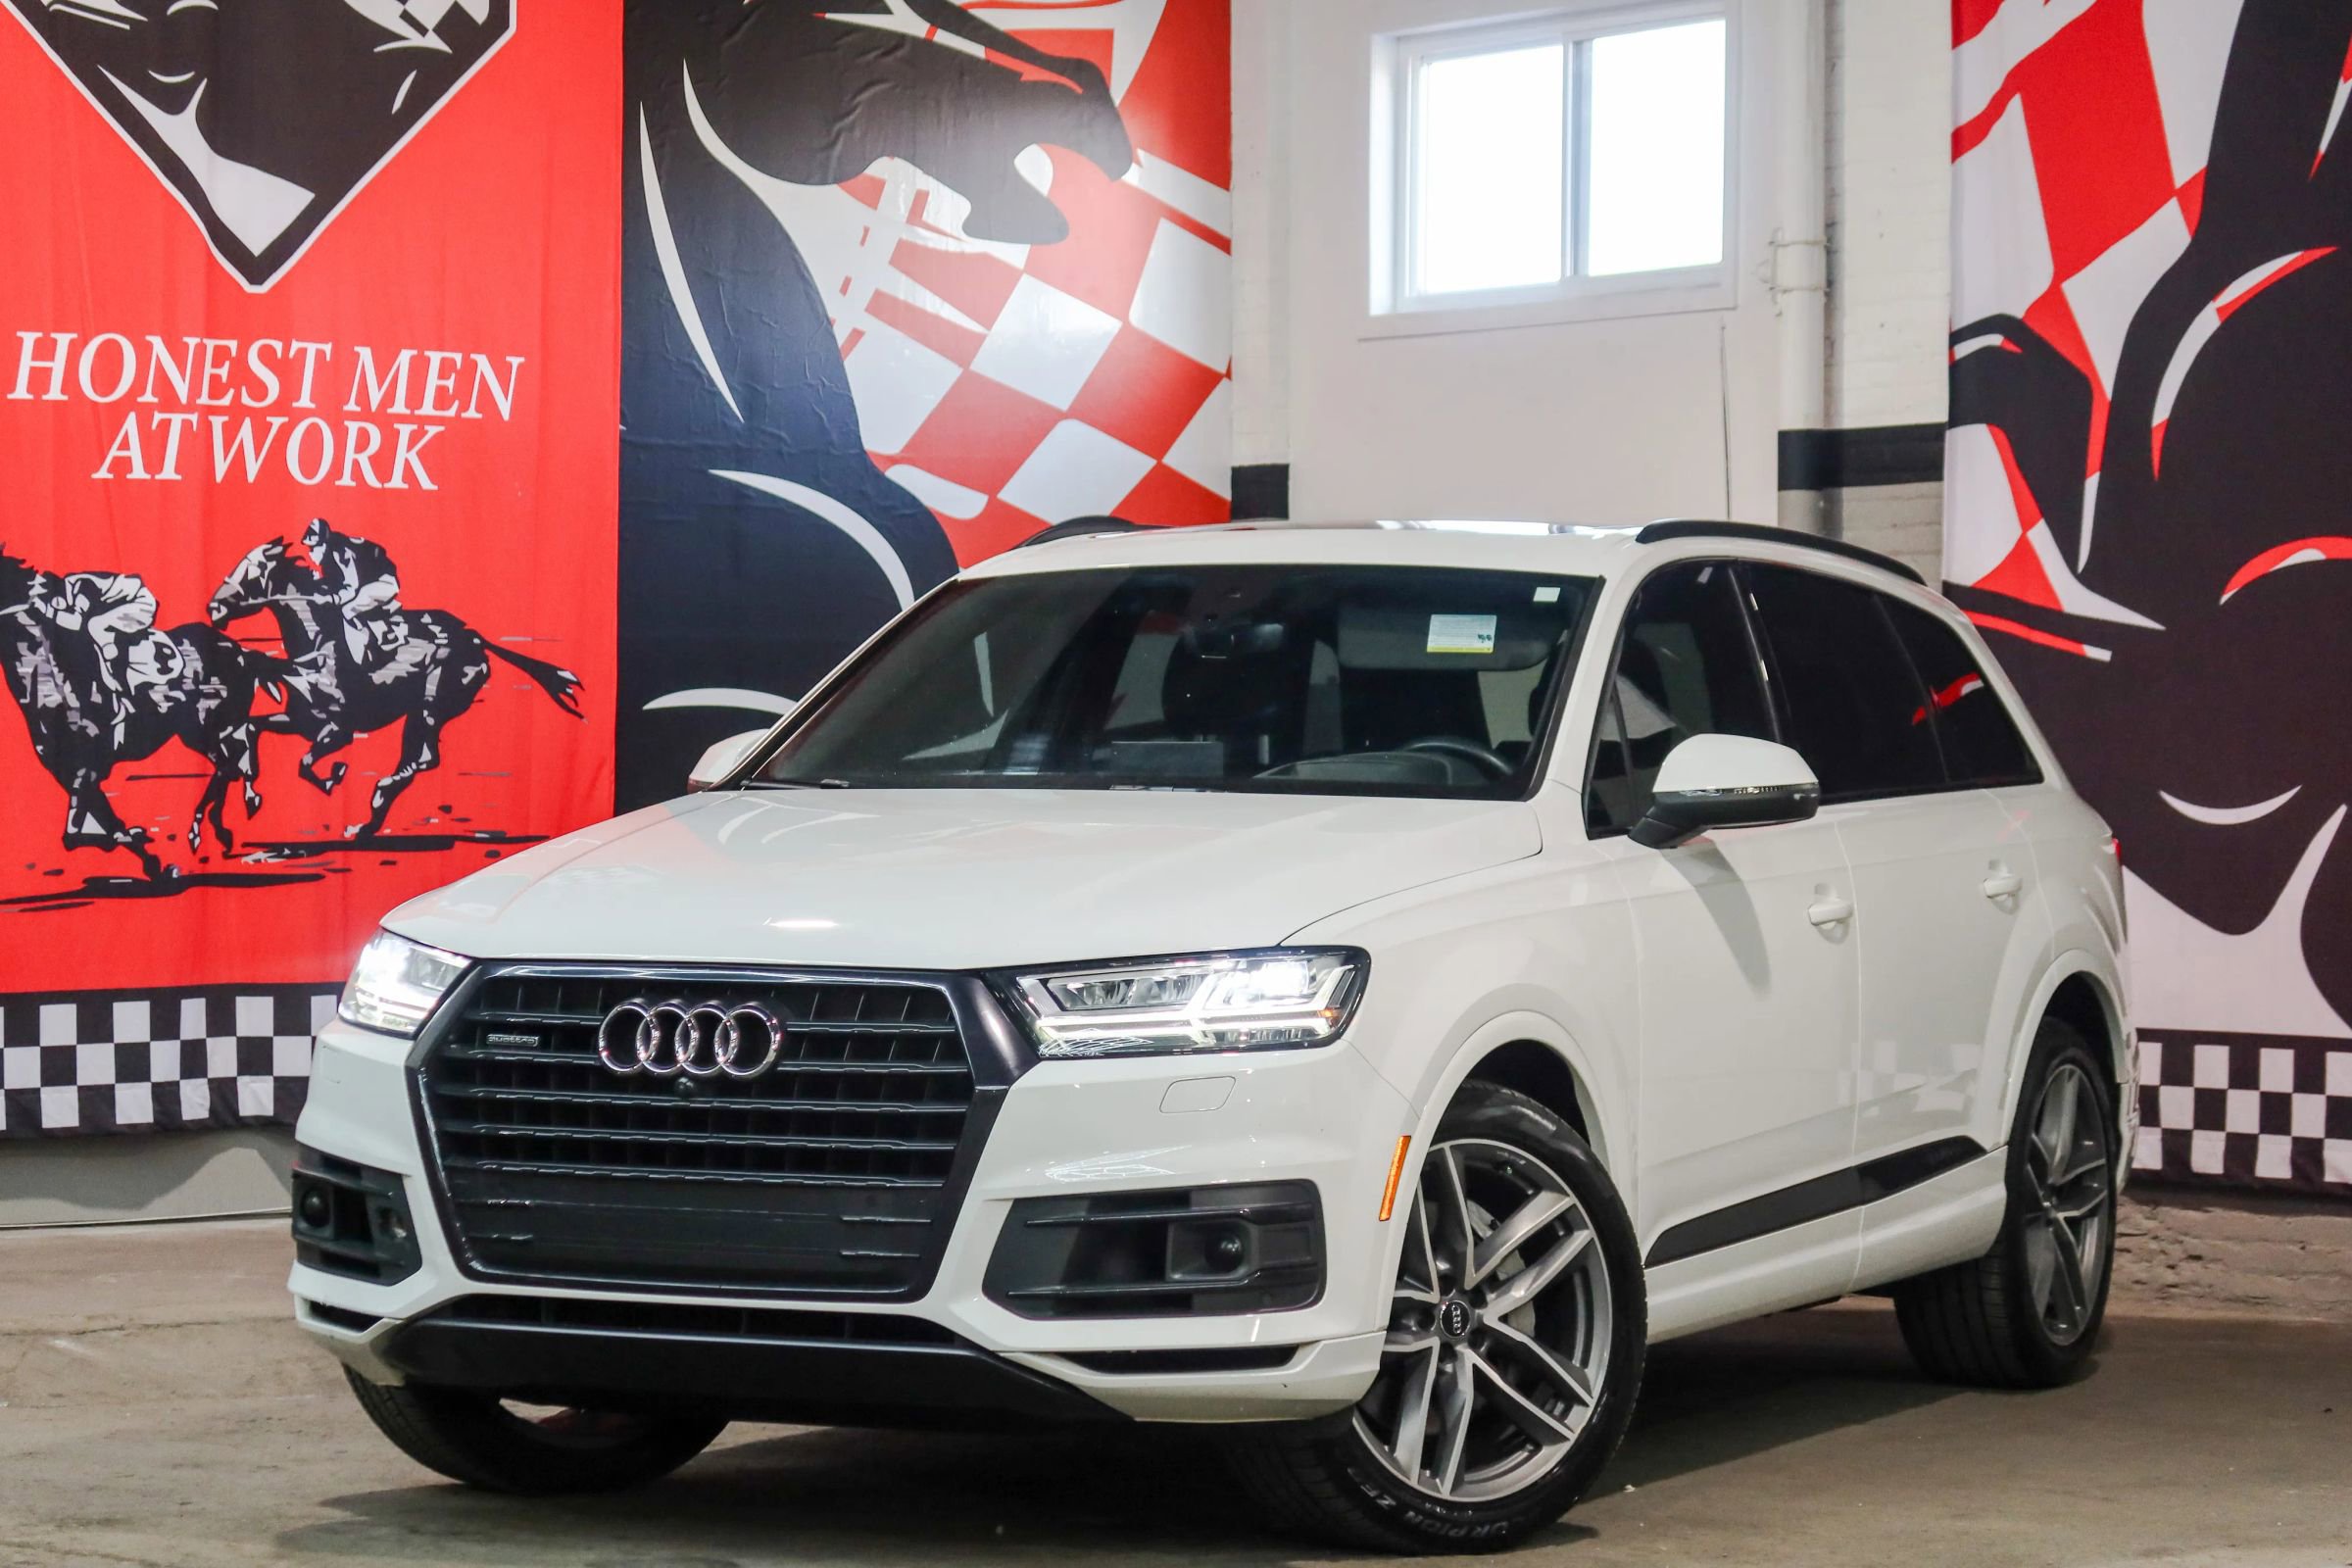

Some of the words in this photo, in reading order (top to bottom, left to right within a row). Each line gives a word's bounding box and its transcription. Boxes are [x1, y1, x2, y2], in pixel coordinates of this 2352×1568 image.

[7, 331, 333, 409] HONEST
[343, 345, 525, 421] MEN
[91, 411, 199, 480] AT
[208, 415, 446, 491] WORK
